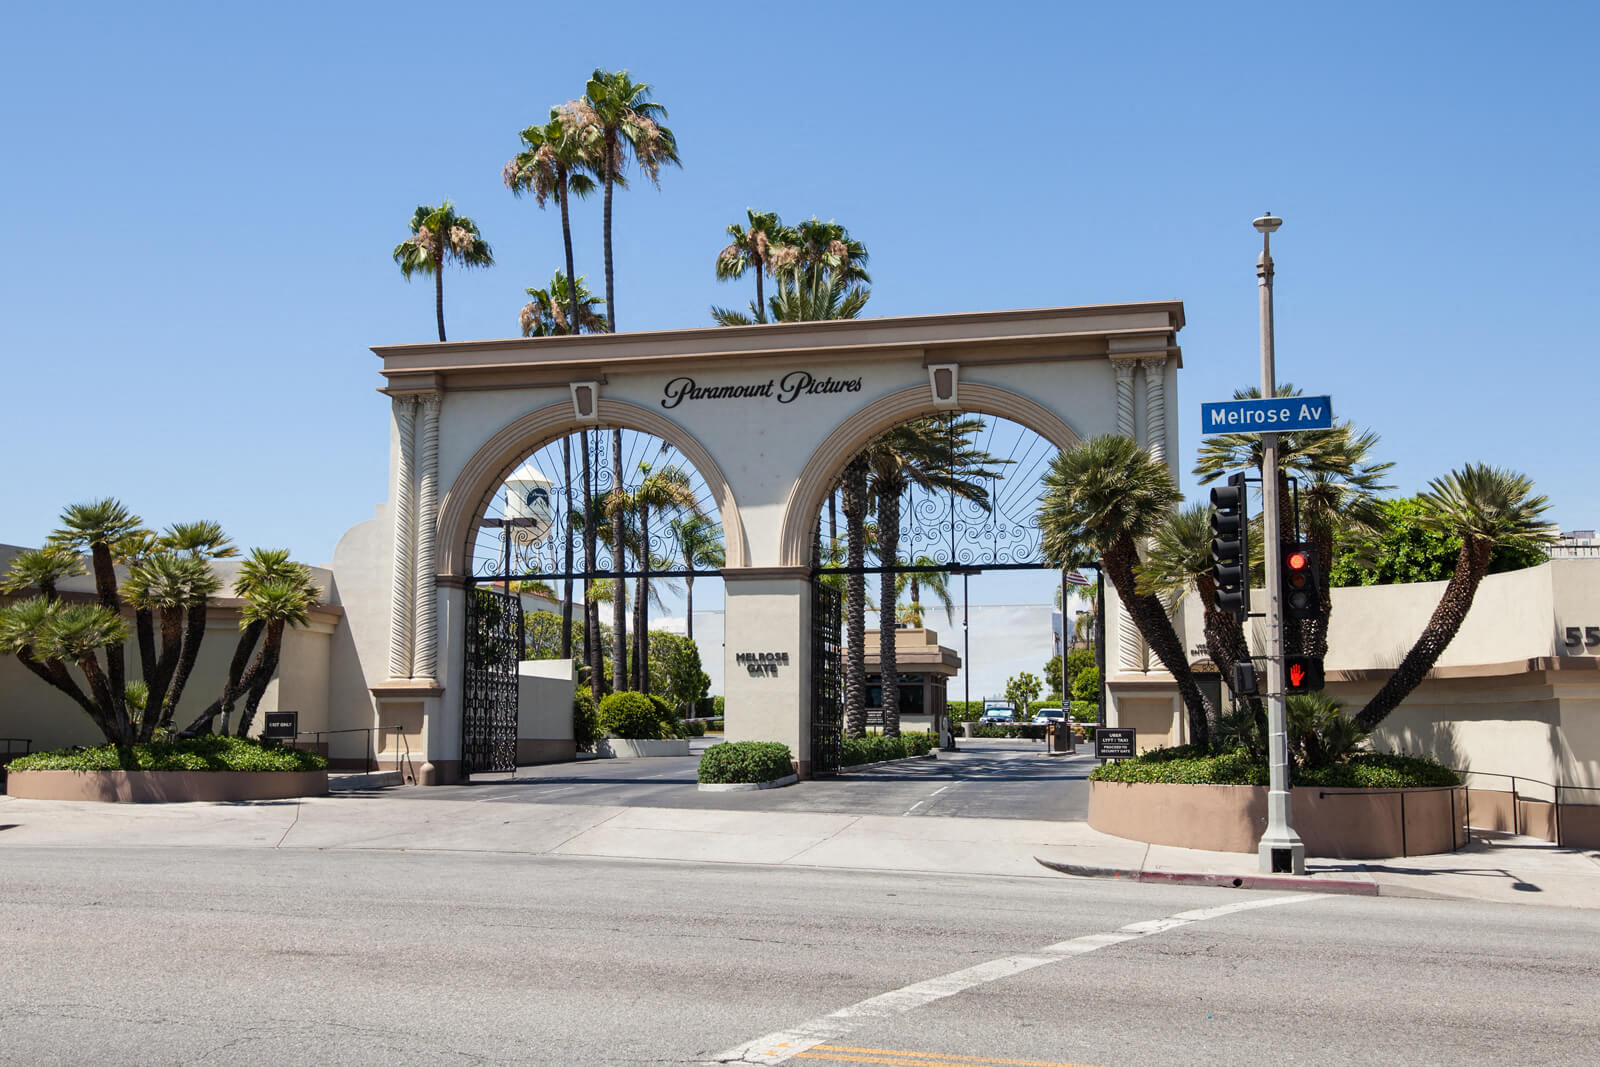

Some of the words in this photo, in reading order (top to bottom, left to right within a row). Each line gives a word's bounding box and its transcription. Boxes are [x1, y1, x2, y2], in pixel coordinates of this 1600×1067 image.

[661, 377, 774, 409] Paramount
[777, 371, 863, 404] Pictures
[1211, 407, 1291, 425] Melrose
[1298, 403, 1322, 421] Av
[736, 652, 788, 662] MELROSE
[747, 663, 778, 673] GATE
